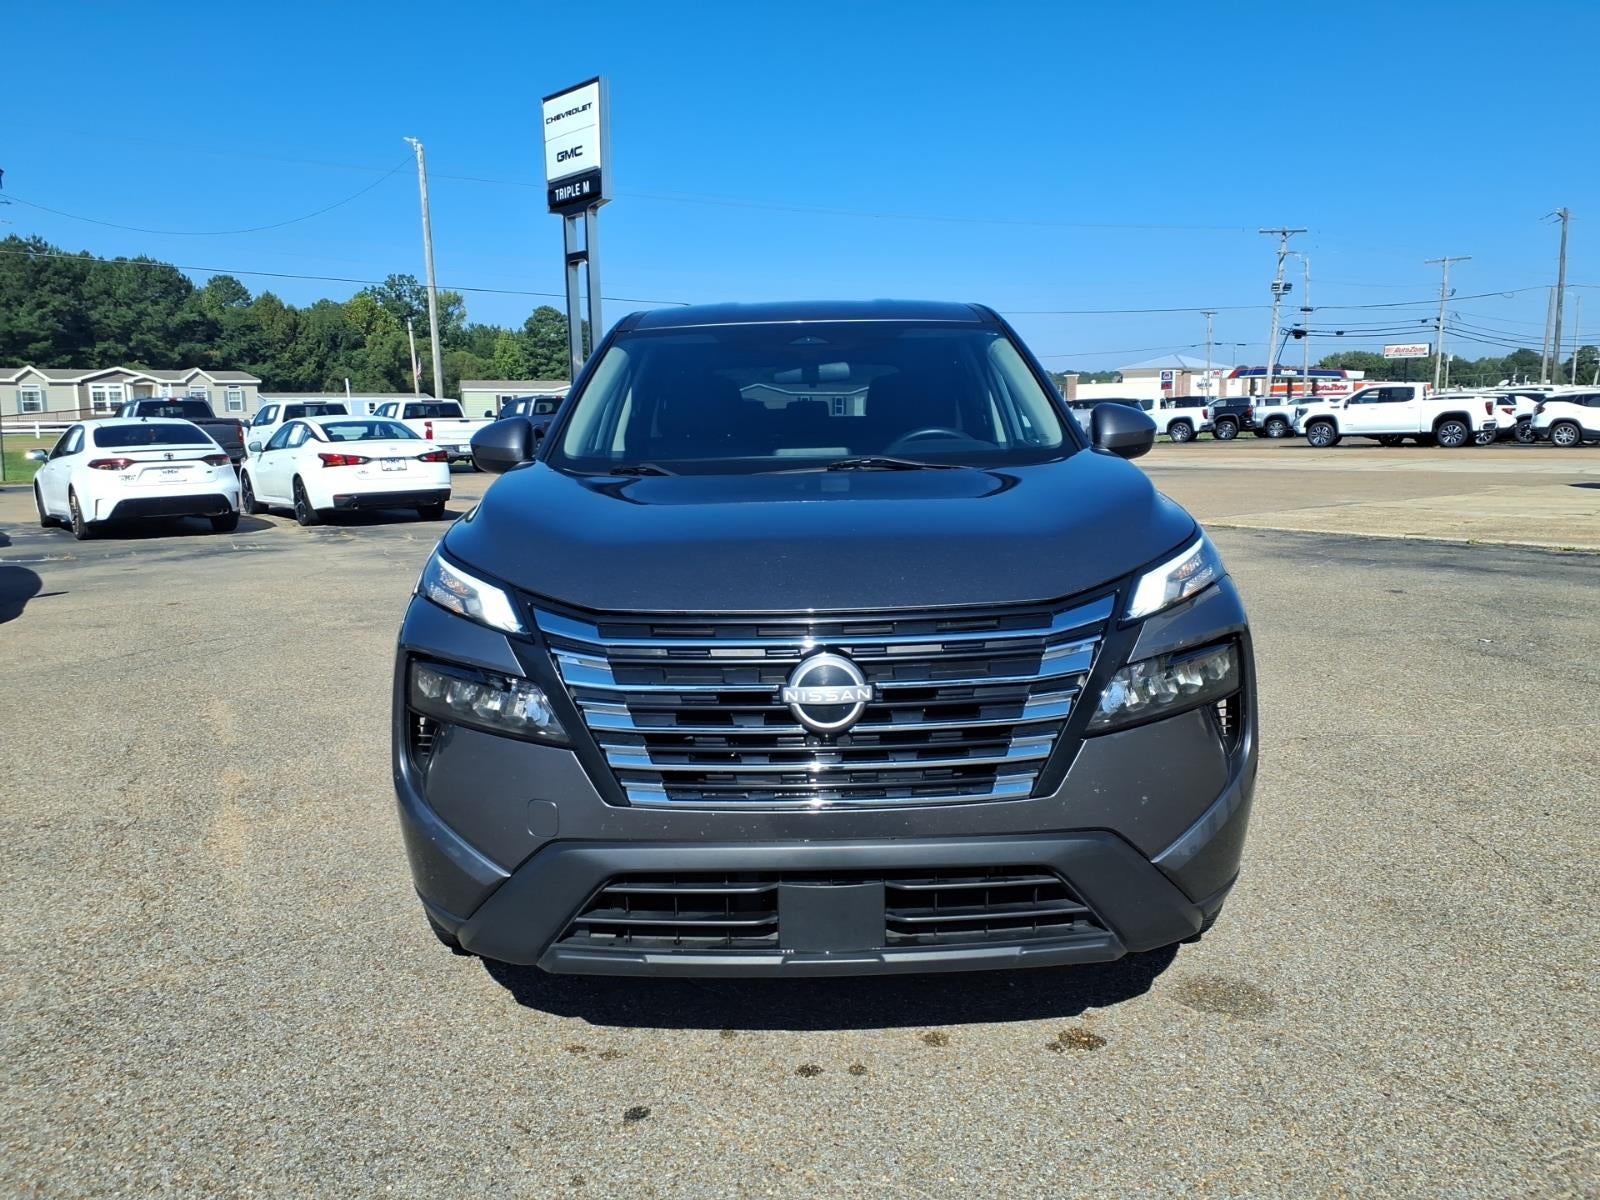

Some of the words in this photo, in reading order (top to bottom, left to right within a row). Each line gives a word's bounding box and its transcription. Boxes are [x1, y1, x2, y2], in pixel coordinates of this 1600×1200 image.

[545, 102, 592, 125] CHEVROLET
[556, 145, 583, 163] GMC
[555, 183, 581, 201] TRIPLE
[582, 180, 590, 194] M
[1393, 346, 1427, 354] AutoZone
[784, 688, 871, 702] NISSAN
